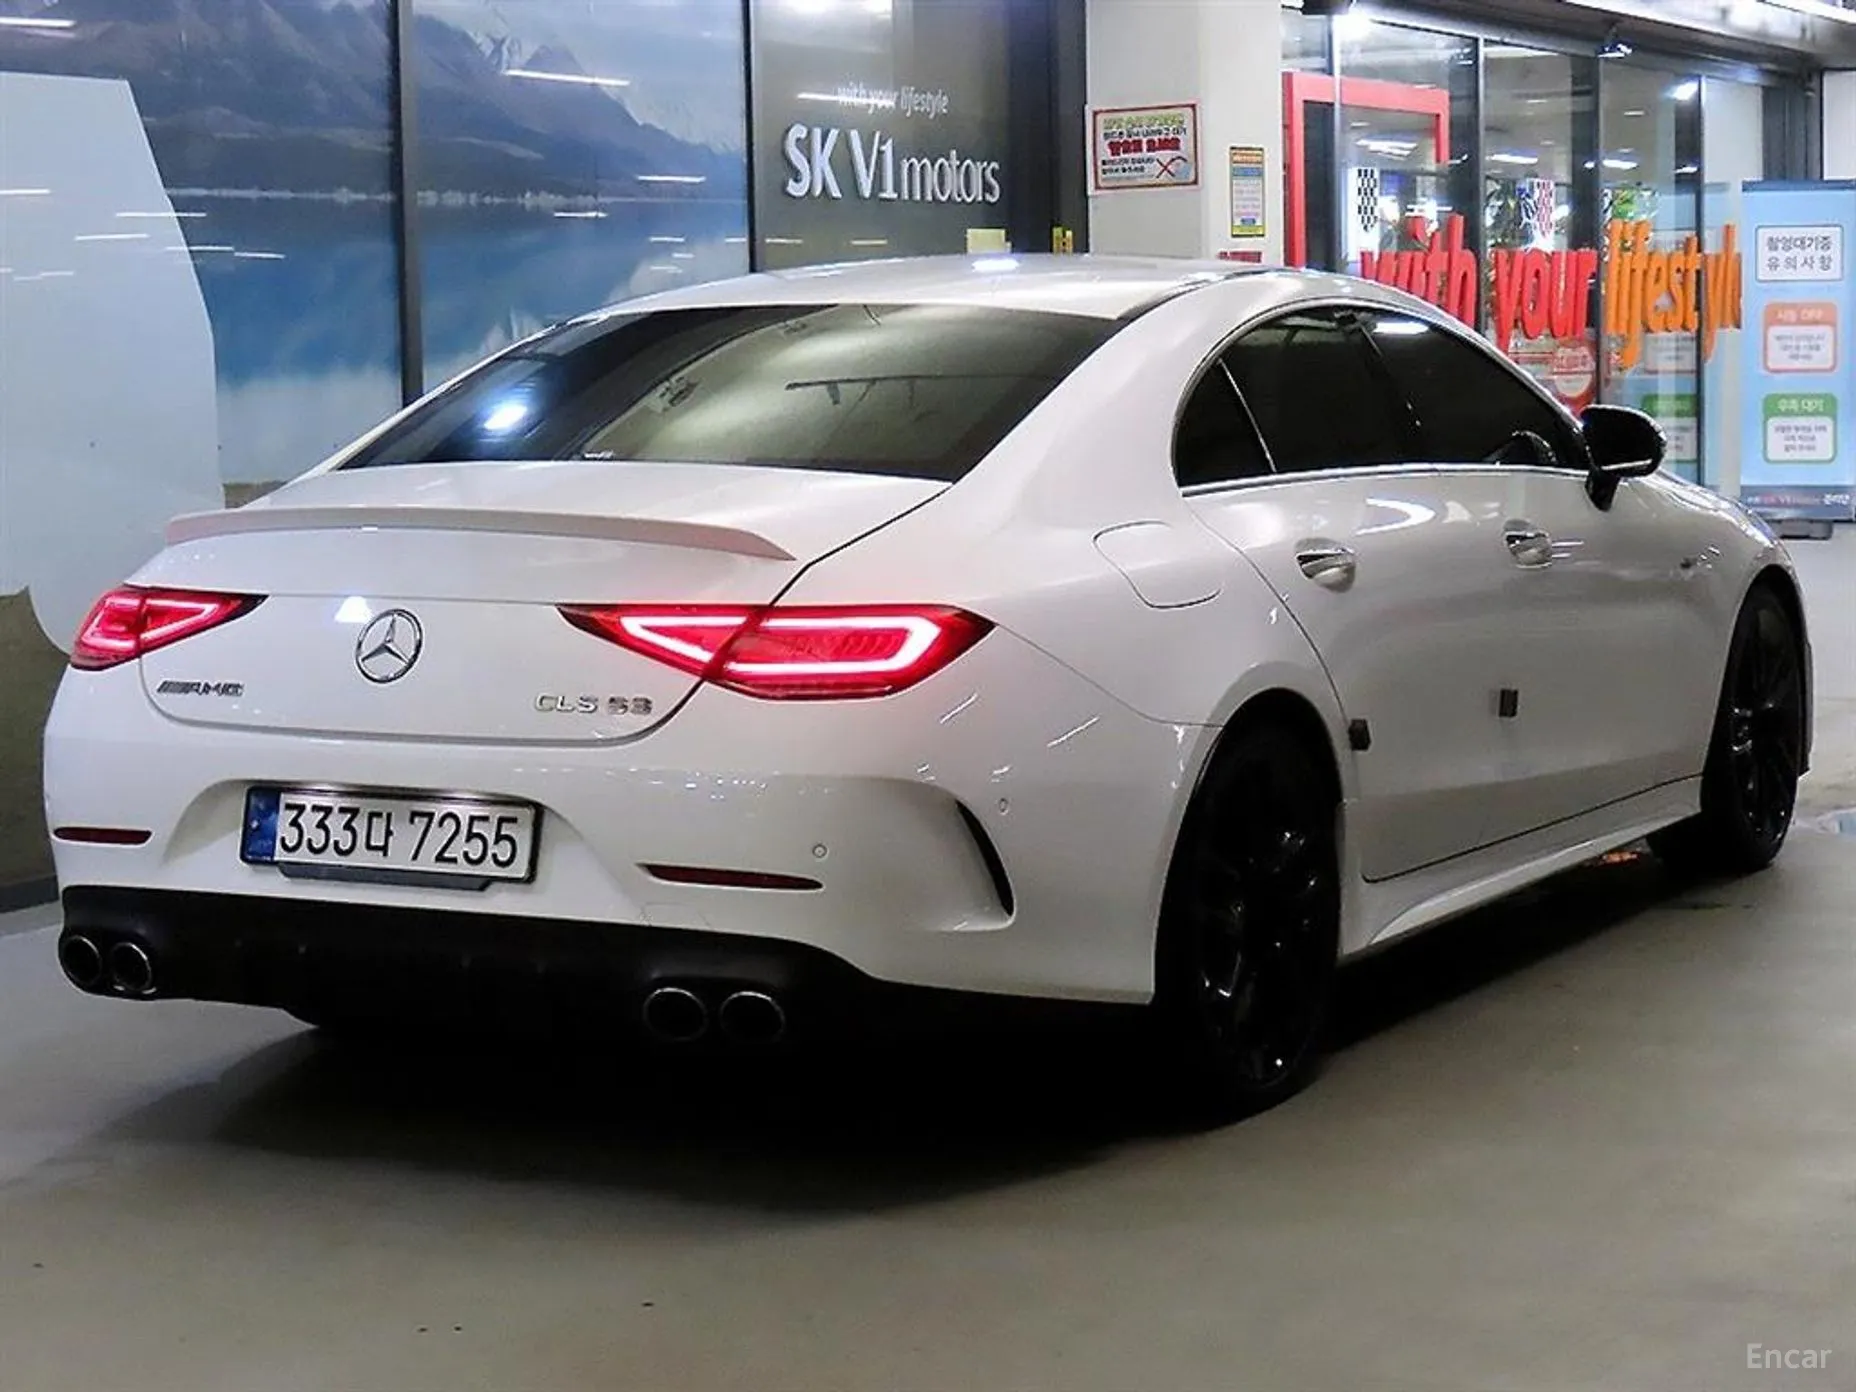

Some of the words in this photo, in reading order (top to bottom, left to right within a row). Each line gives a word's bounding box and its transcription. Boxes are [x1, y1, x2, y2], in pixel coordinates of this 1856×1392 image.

[837, 81, 868, 107] with
[868, 89, 899, 115] your
[900, 86, 949, 119] lifestyle
[785, 123, 842, 199] SK
[849, 129, 899, 199] V1
[900, 149, 1000, 203] motors
[1766, 235, 1833, 253] 촬영대기중
[1494, 247, 1597, 354] your
[180, 681, 244, 698] AMG
[535, 693, 599, 714] CLS
[607, 696, 653, 716] 53
[280, 802, 394, 857] 333다
[409, 810, 518, 869] 7255
